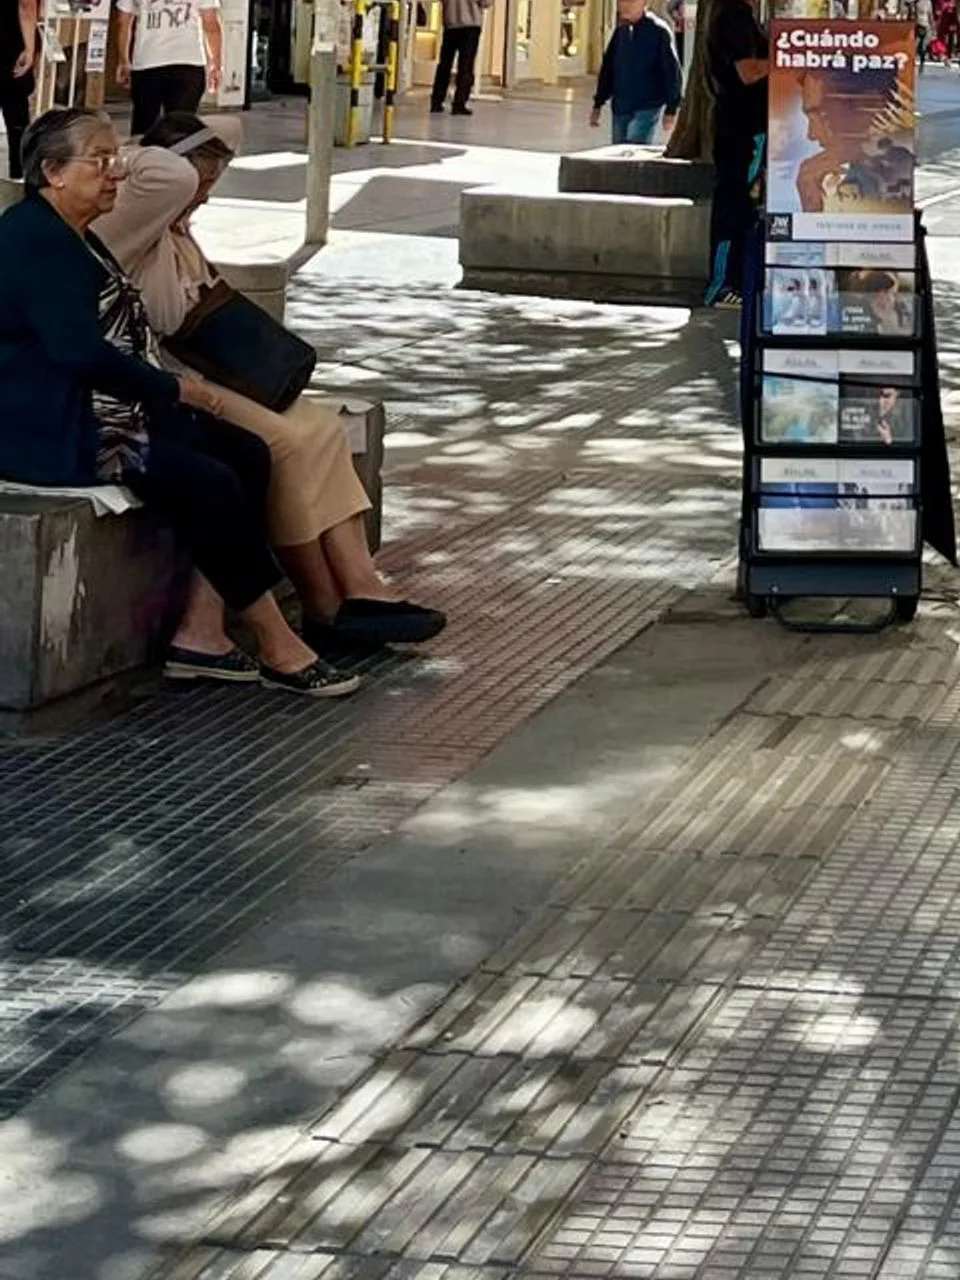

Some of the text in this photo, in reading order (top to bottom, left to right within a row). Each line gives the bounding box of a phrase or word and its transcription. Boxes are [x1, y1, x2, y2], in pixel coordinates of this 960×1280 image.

[776, 28, 880, 49] ¿Cuándo
[775, 50, 908, 72] habrá paz?
